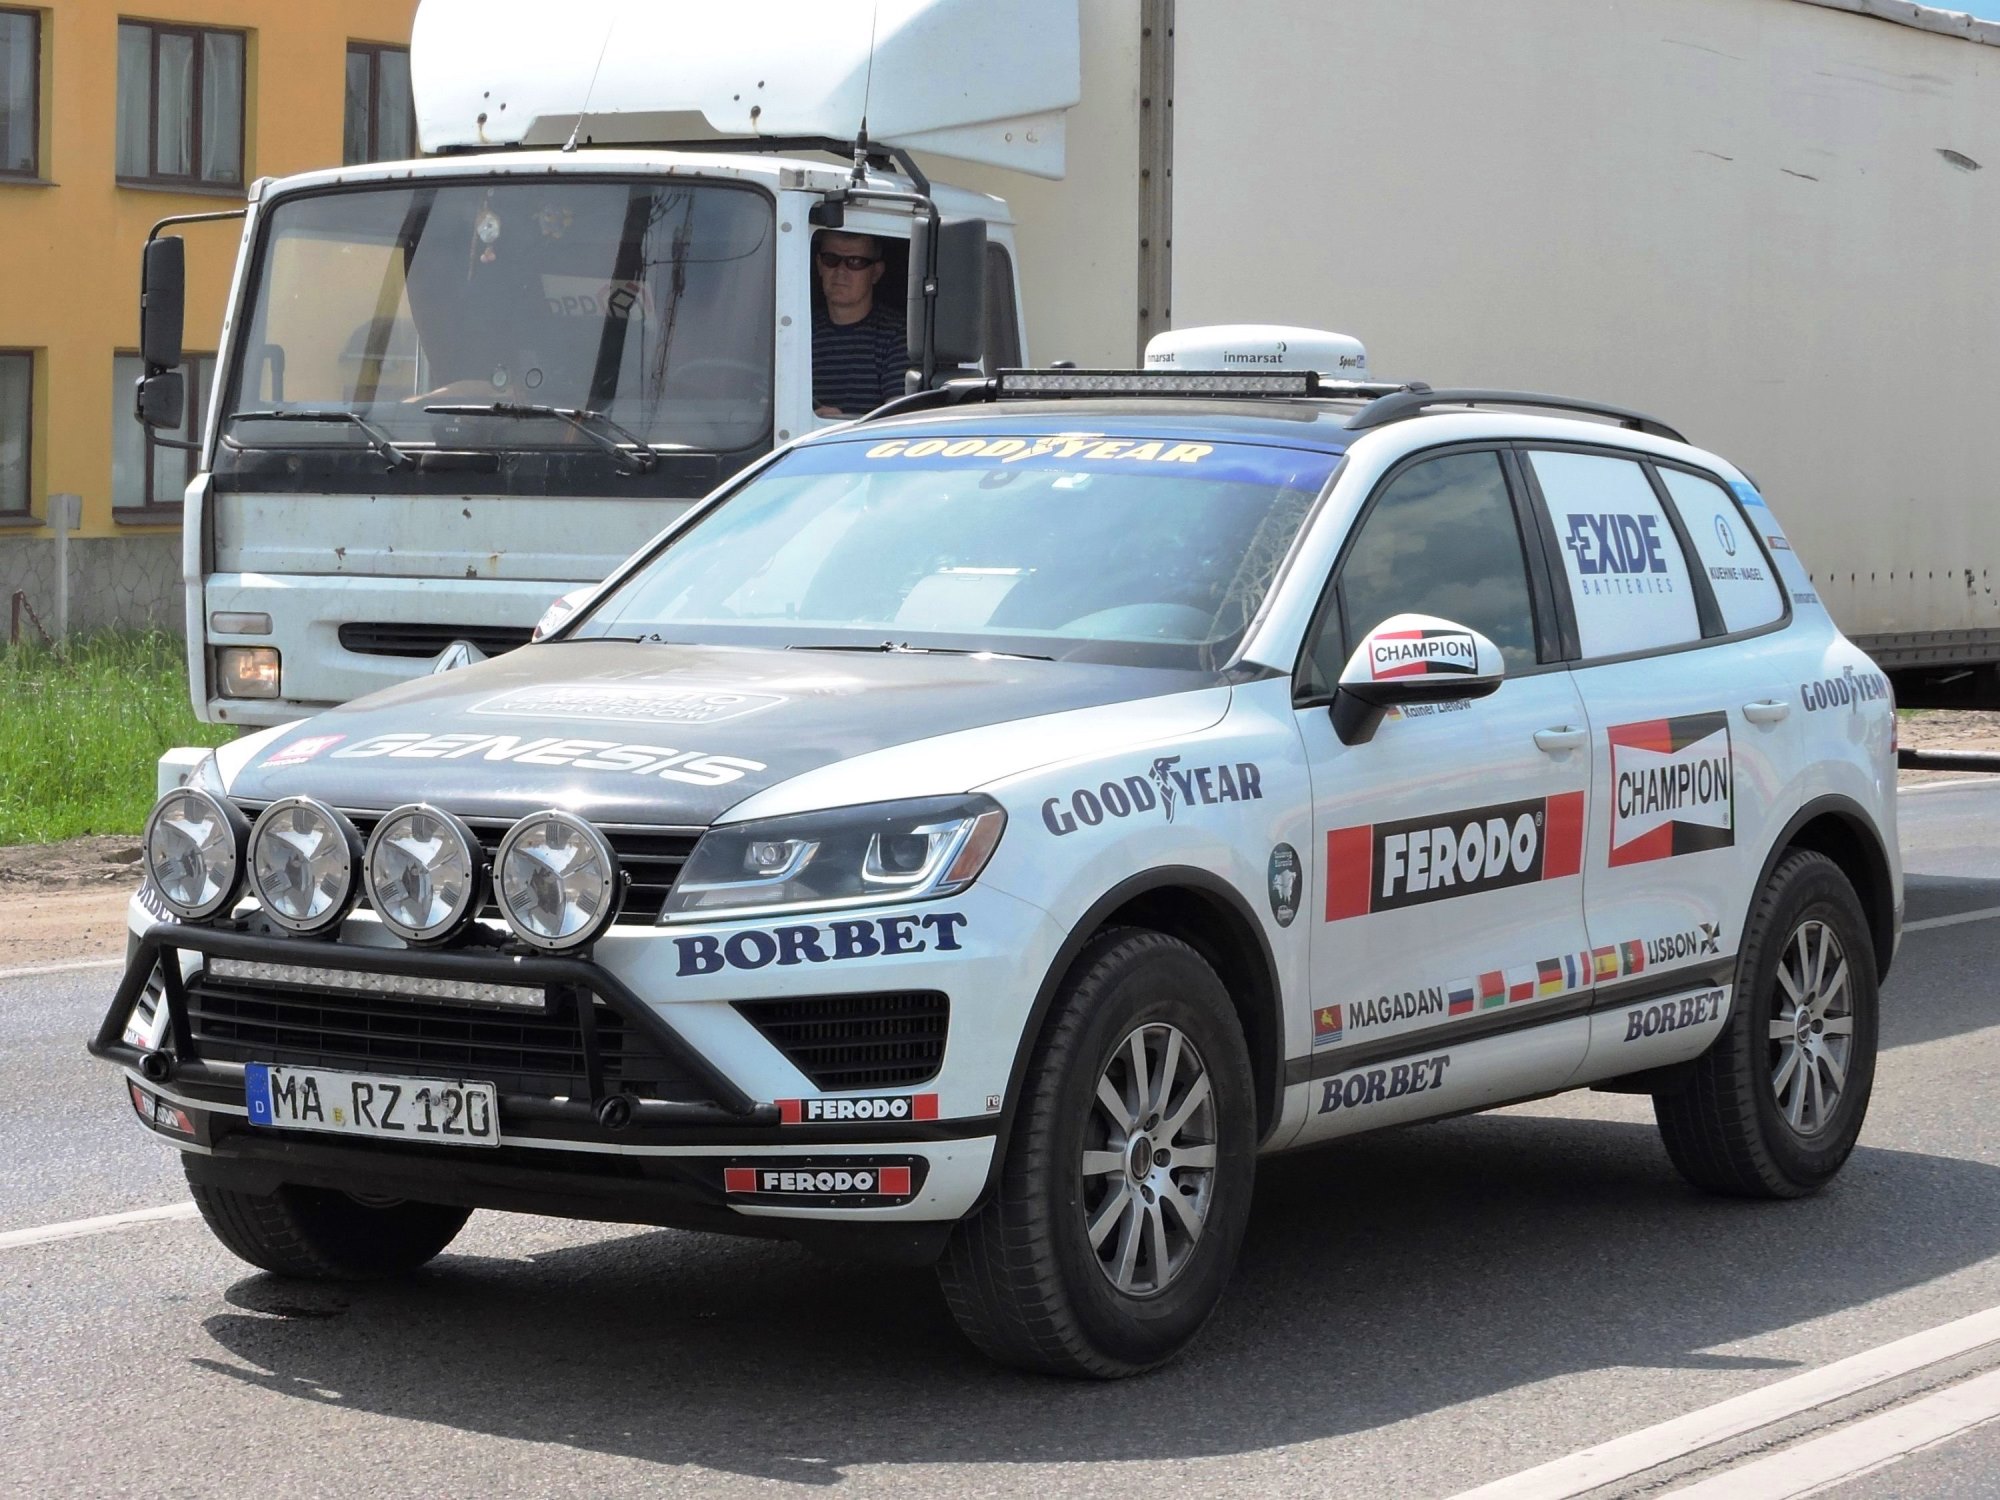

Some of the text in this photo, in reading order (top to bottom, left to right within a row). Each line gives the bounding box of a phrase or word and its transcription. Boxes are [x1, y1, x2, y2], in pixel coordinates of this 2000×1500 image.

[1224, 351, 1282, 363] inmarsat
[865, 438, 1213, 463] GOODYEAR
[1565, 514, 1668, 574] EXIDE
[1582, 579, 1673, 594] BATTERIES
[1375, 641, 1472, 662] CHAMPION
[330, 733, 767, 786] GENESIS
[1041, 757, 1263, 836] GOODYEAR
[1618, 757, 1727, 819] CHAMPION
[1382, 813, 1537, 897] FERODO
[672, 912, 968, 977] BORBET
[1648, 931, 1697, 966] LISBON
[1350, 986, 1443, 1030] MAGADAN
[1624, 990, 1724, 1043] BORBET
[256, 1100, 265, 1114] D
[271, 1073, 490, 1136] MA RZ 120
[808, 1098, 908, 1120] FERODO
[1318, 1055, 1450, 1115] BORBET
[763, 1171, 874, 1191] FERODO
